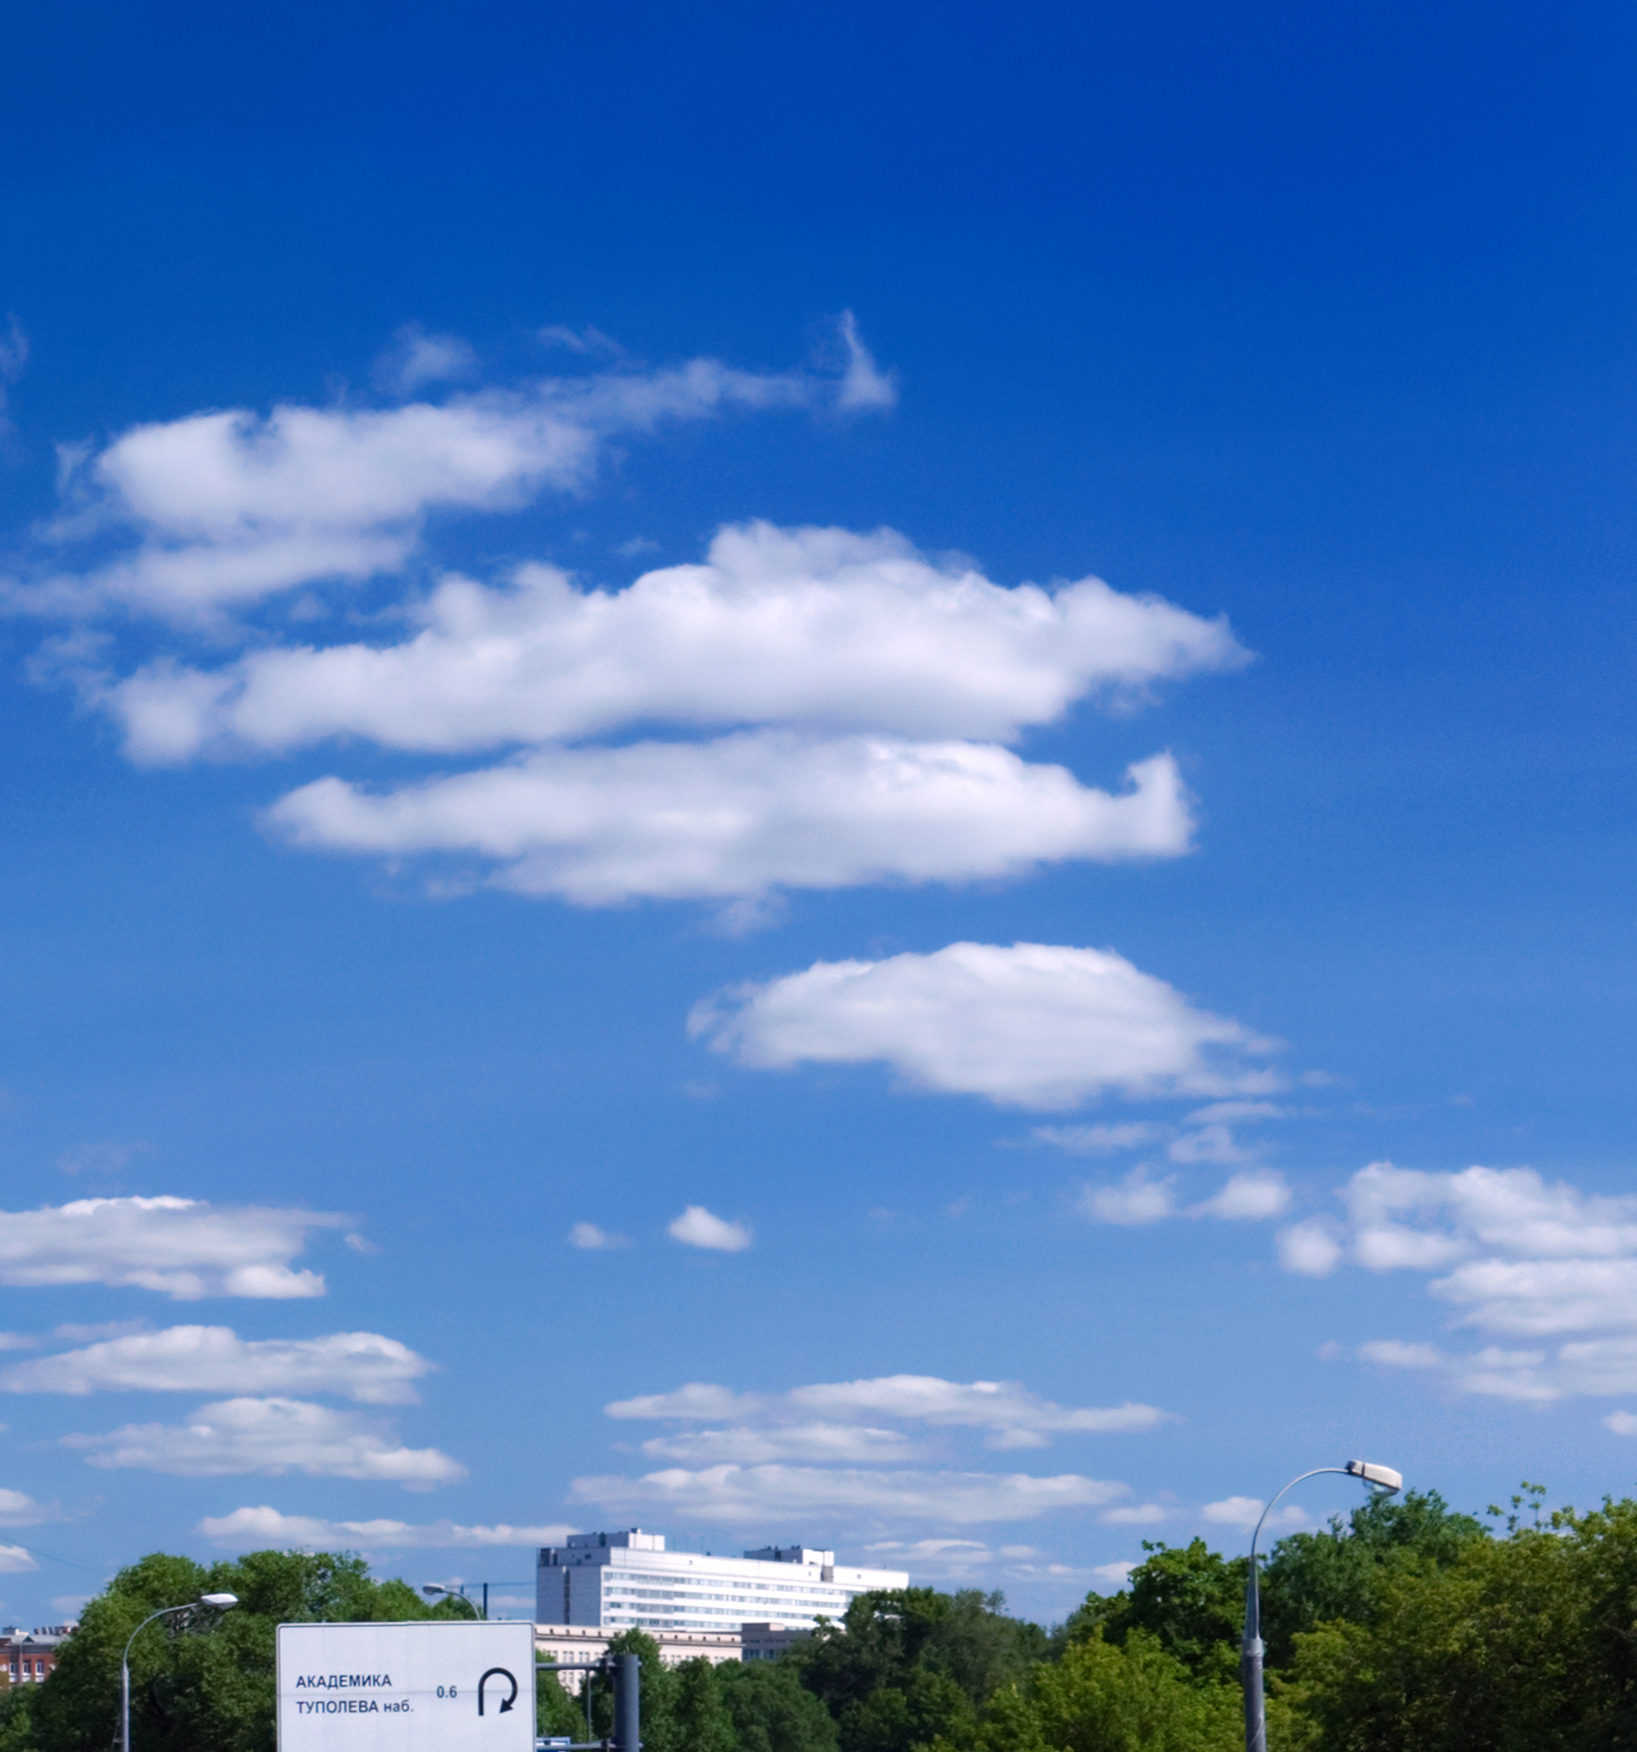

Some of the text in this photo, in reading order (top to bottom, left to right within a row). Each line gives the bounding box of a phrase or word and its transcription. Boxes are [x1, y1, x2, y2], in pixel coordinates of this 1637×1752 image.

[296, 1675, 392, 1689] АКАДЕМИКА
[436, 1685, 458, 1698] 0.6
[296, 1699, 414, 1713] ТУПОЛЕВА наб.
